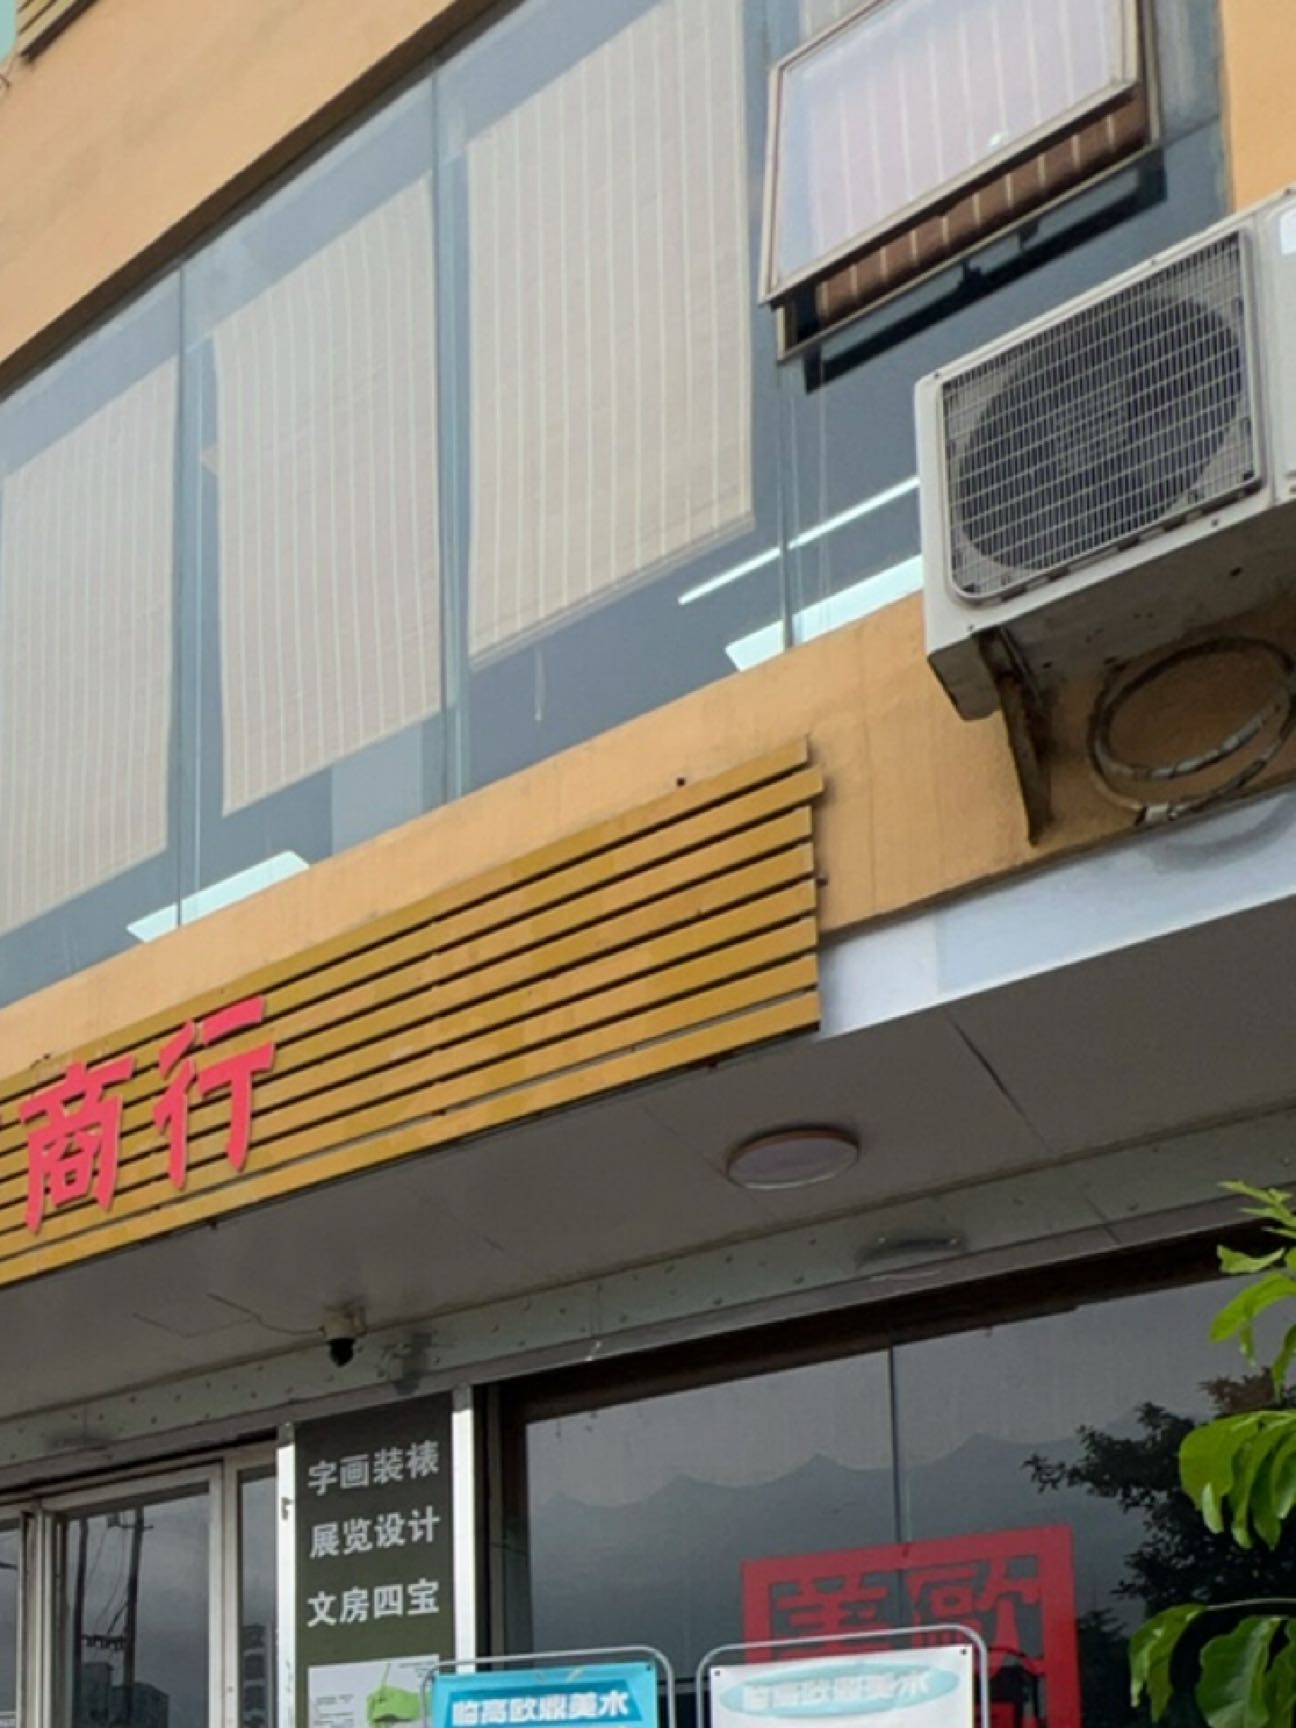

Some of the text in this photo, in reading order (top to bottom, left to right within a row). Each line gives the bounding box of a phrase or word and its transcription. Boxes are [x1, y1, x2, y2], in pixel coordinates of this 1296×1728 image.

[307, 1440, 439, 1496] 字画装裱
[310, 1505, 441, 1558] 展览设计
[307, 1577, 439, 1628] 文房四宝
